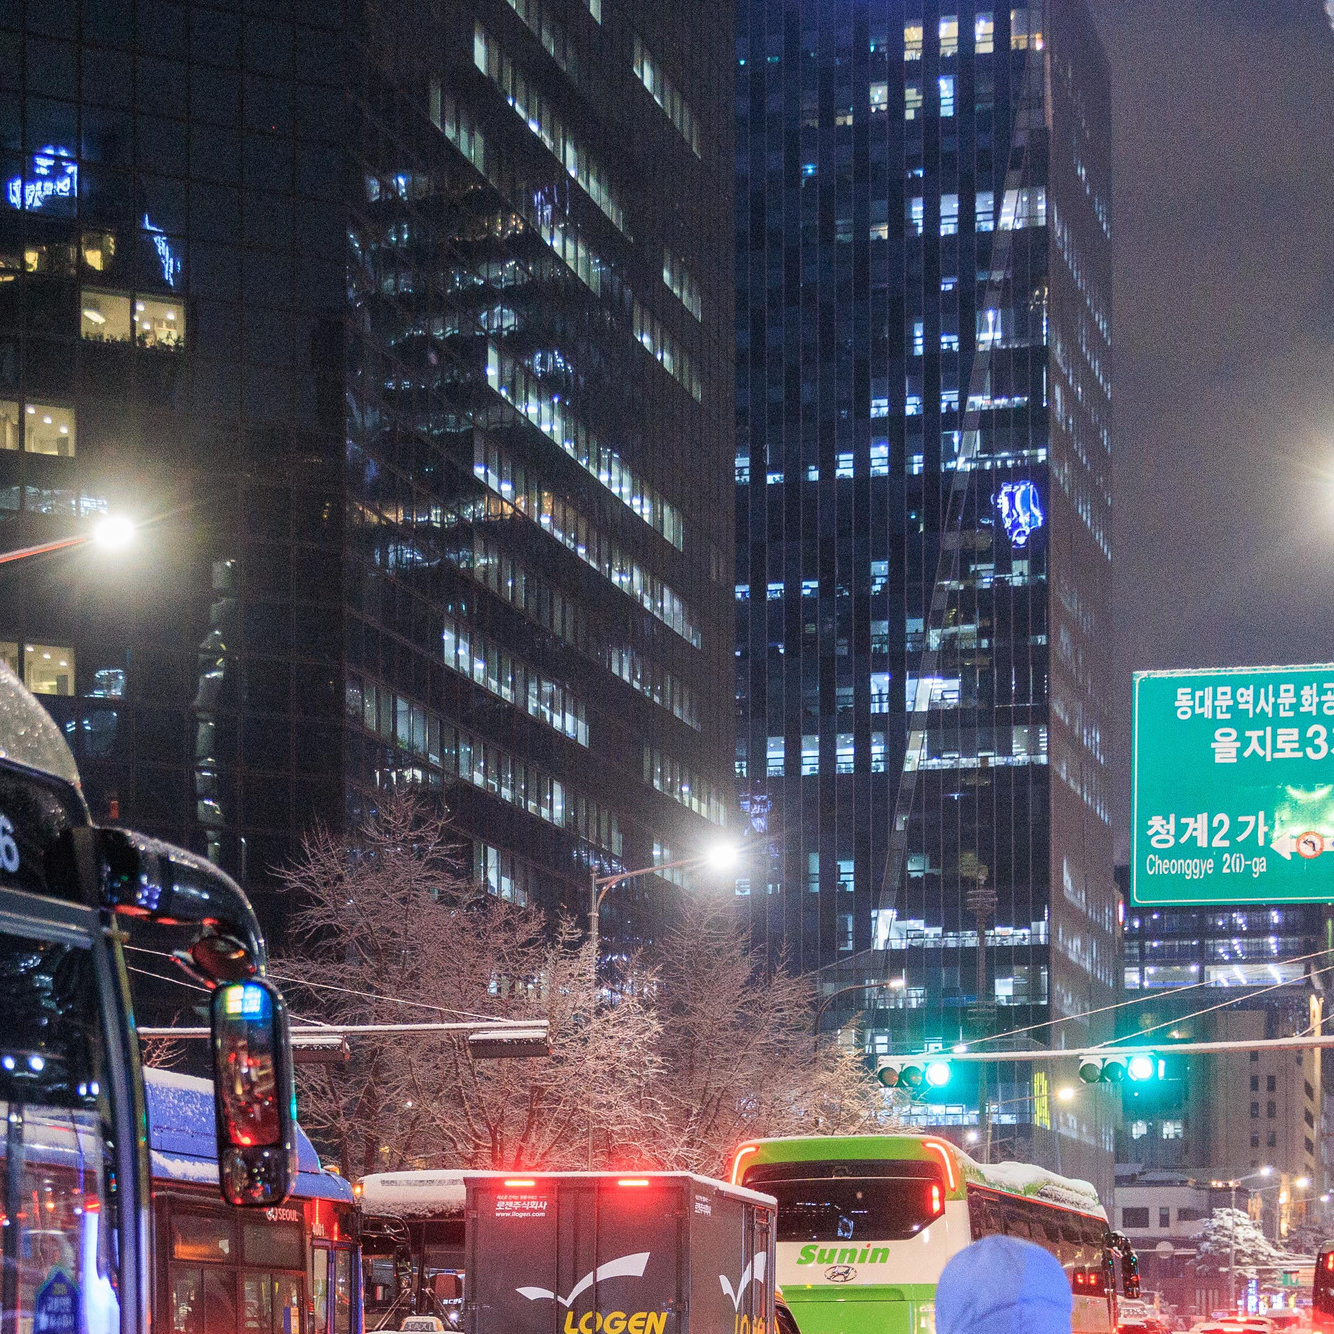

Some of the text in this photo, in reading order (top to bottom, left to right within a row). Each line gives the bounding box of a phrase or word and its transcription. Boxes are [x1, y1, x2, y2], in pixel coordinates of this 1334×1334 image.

[1146, 853, 1267, 879] Cheonggye 2(i)-ga
[279, 1208, 299, 1222] SEOUL
[796, 1243, 890, 1265] Sunin
[407, 1322, 433, 1331] TAXI
